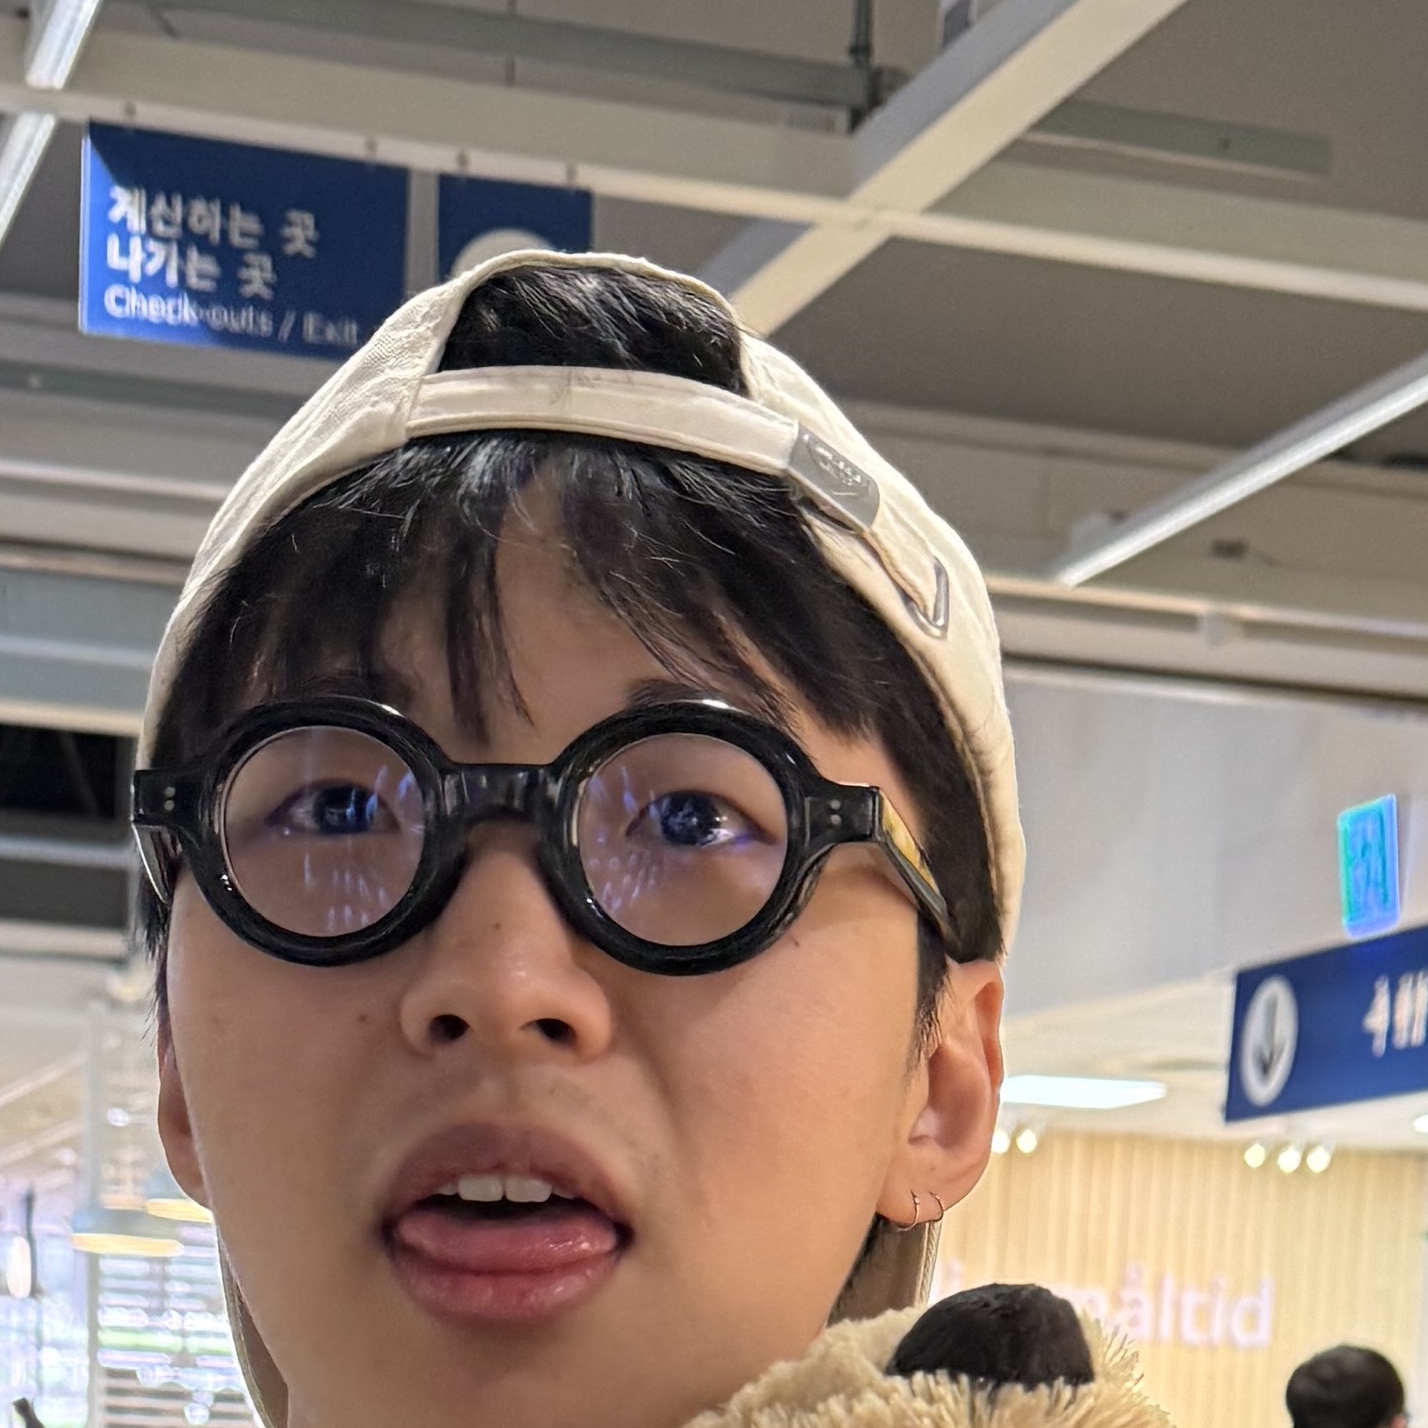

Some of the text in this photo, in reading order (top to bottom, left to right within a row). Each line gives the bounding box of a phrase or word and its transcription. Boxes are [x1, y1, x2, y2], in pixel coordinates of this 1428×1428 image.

[280, 207, 321, 260] 곳
[238, 252, 277, 300] 곳
[104, 286, 273, 338] Check-outs
[303, 312, 359, 348] Exit
